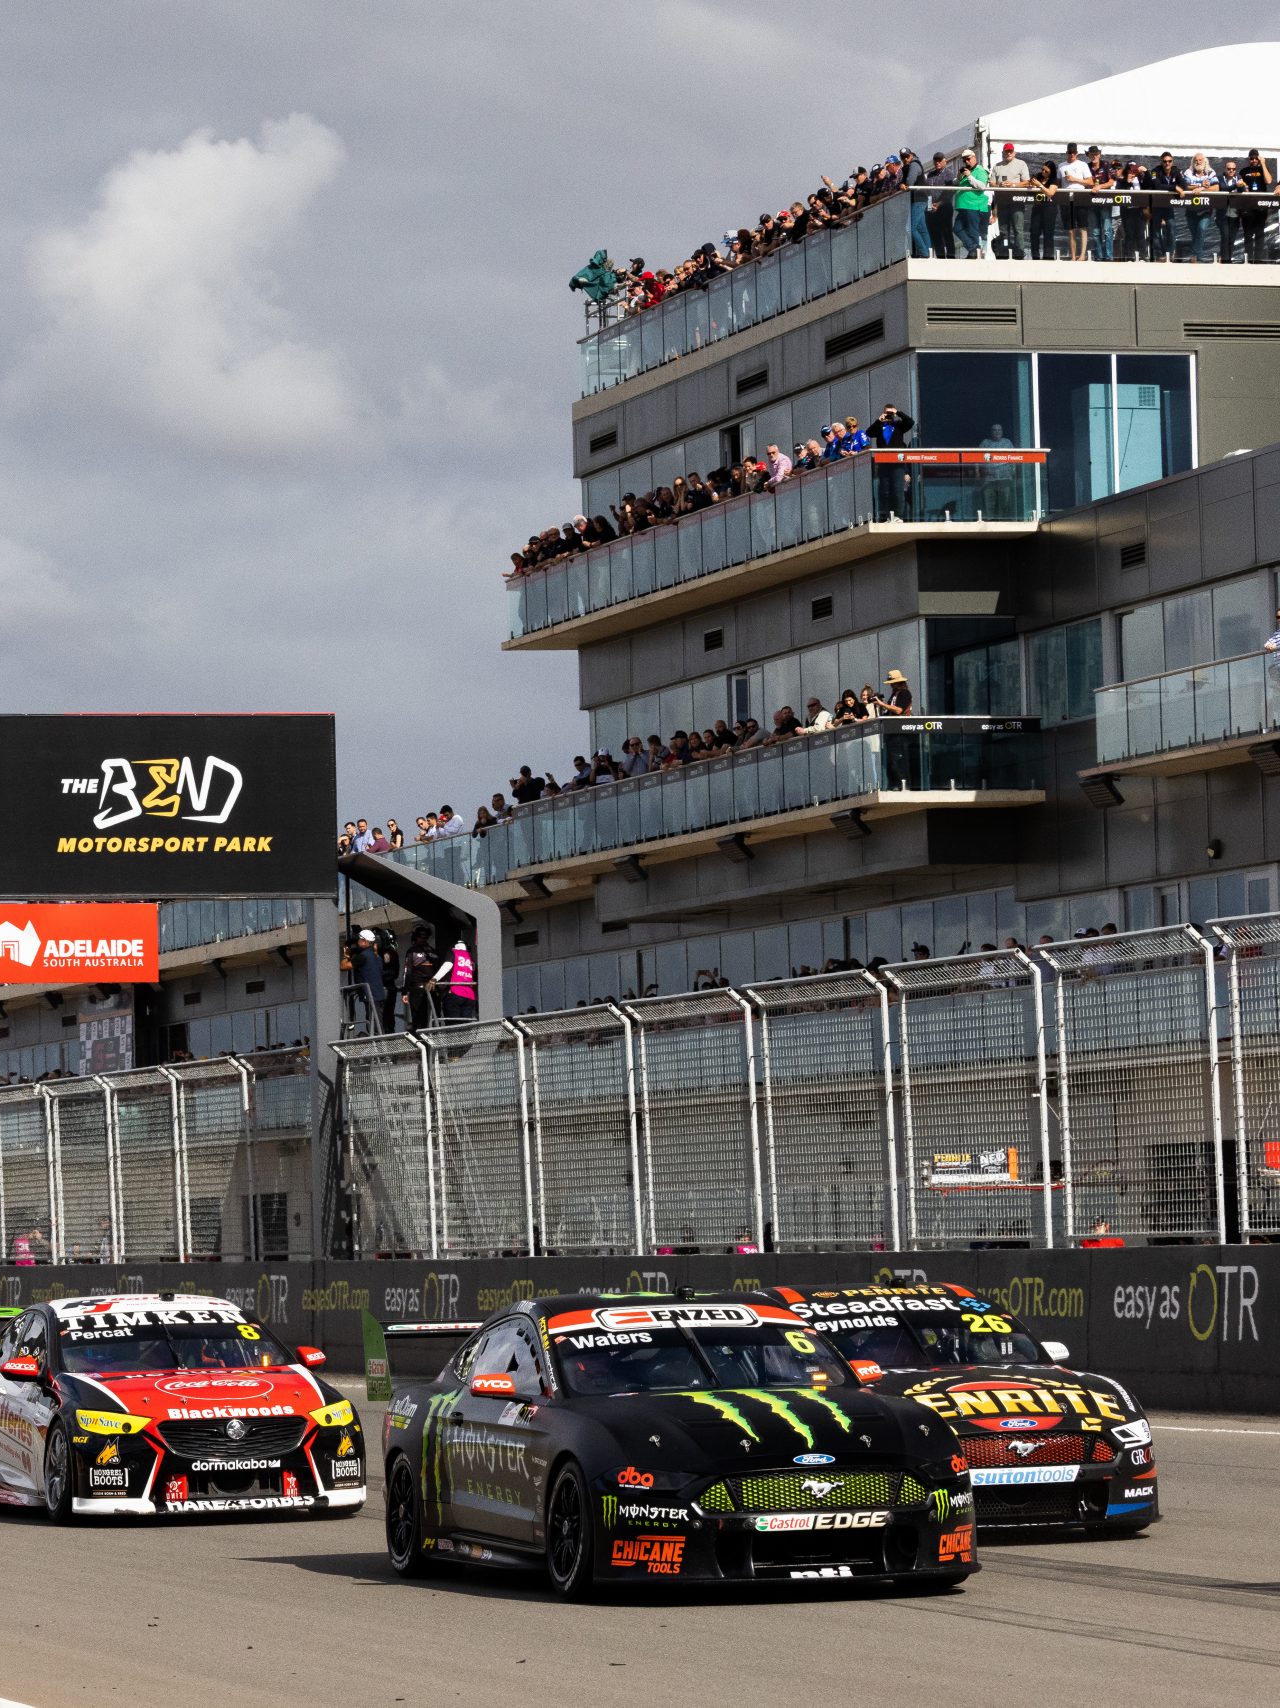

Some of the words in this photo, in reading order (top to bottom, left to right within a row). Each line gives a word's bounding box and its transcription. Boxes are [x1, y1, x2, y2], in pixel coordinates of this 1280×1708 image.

[1114, 195, 1132, 204] OTR
[1193, 197, 1210, 206] OTR
[925, 721, 943, 731] OTR
[61, 778, 100, 794] THE
[93, 755, 244, 830] BEND
[57, 836, 209, 853] MOTORSPORT
[213, 836, 274, 852] PARK
[43, 939, 144, 957] ADELAIDE
[43, 958, 81, 967] SOUTH
[85, 958, 144, 967] AUSTRALIA
[384, 1287, 408, 1318] easy
[408, 1288, 420, 1312] as
[423, 1271, 460, 1319] OTR
[841, 1286, 947, 1297] PENRITE
[788, 1296, 961, 1320] Steadfast
[1113, 1284, 1157, 1330] easy
[1159, 1285, 1180, 1319] as
[1188, 1263, 1260, 1342] OTR
[60, 1309, 248, 1331] TIMKEN
[653, 1308, 745, 1323] ENZED
[813, 1315, 899, 1333] eynolds
[961, 1313, 1013, 1334] 26
[70, 1327, 134, 1341] Percat
[236, 1324, 261, 1340] 8
[568, 1330, 653, 1350] Waters
[783, 1331, 816, 1354] 6
[4, 1362, 36, 1370] sparco
[472, 1379, 512, 1389] RYCO
[167, 1405, 295, 1420] Blackwoods
[913, 1388, 1128, 1422] ENRITE
[448, 1425, 530, 1479] MONSTER
[191, 1459, 267, 1471] dormakaba
[335, 1467, 358, 1476] BOOTS
[93, 1476, 124, 1486] BOOTS
[617, 1466, 655, 1488] dba
[972, 1466, 1075, 1485] suttontools
[467, 1478, 522, 1505] ENERGY
[1124, 1485, 1154, 1499] MACK
[619, 1503, 690, 1522] MONSTER
[769, 1516, 810, 1531] Castrol
[814, 1511, 890, 1530] EDGE
[628, 1520, 678, 1529] ENERGY
[611, 1539, 685, 1563] CHICANE
[647, 1562, 681, 1574] TOOLS
